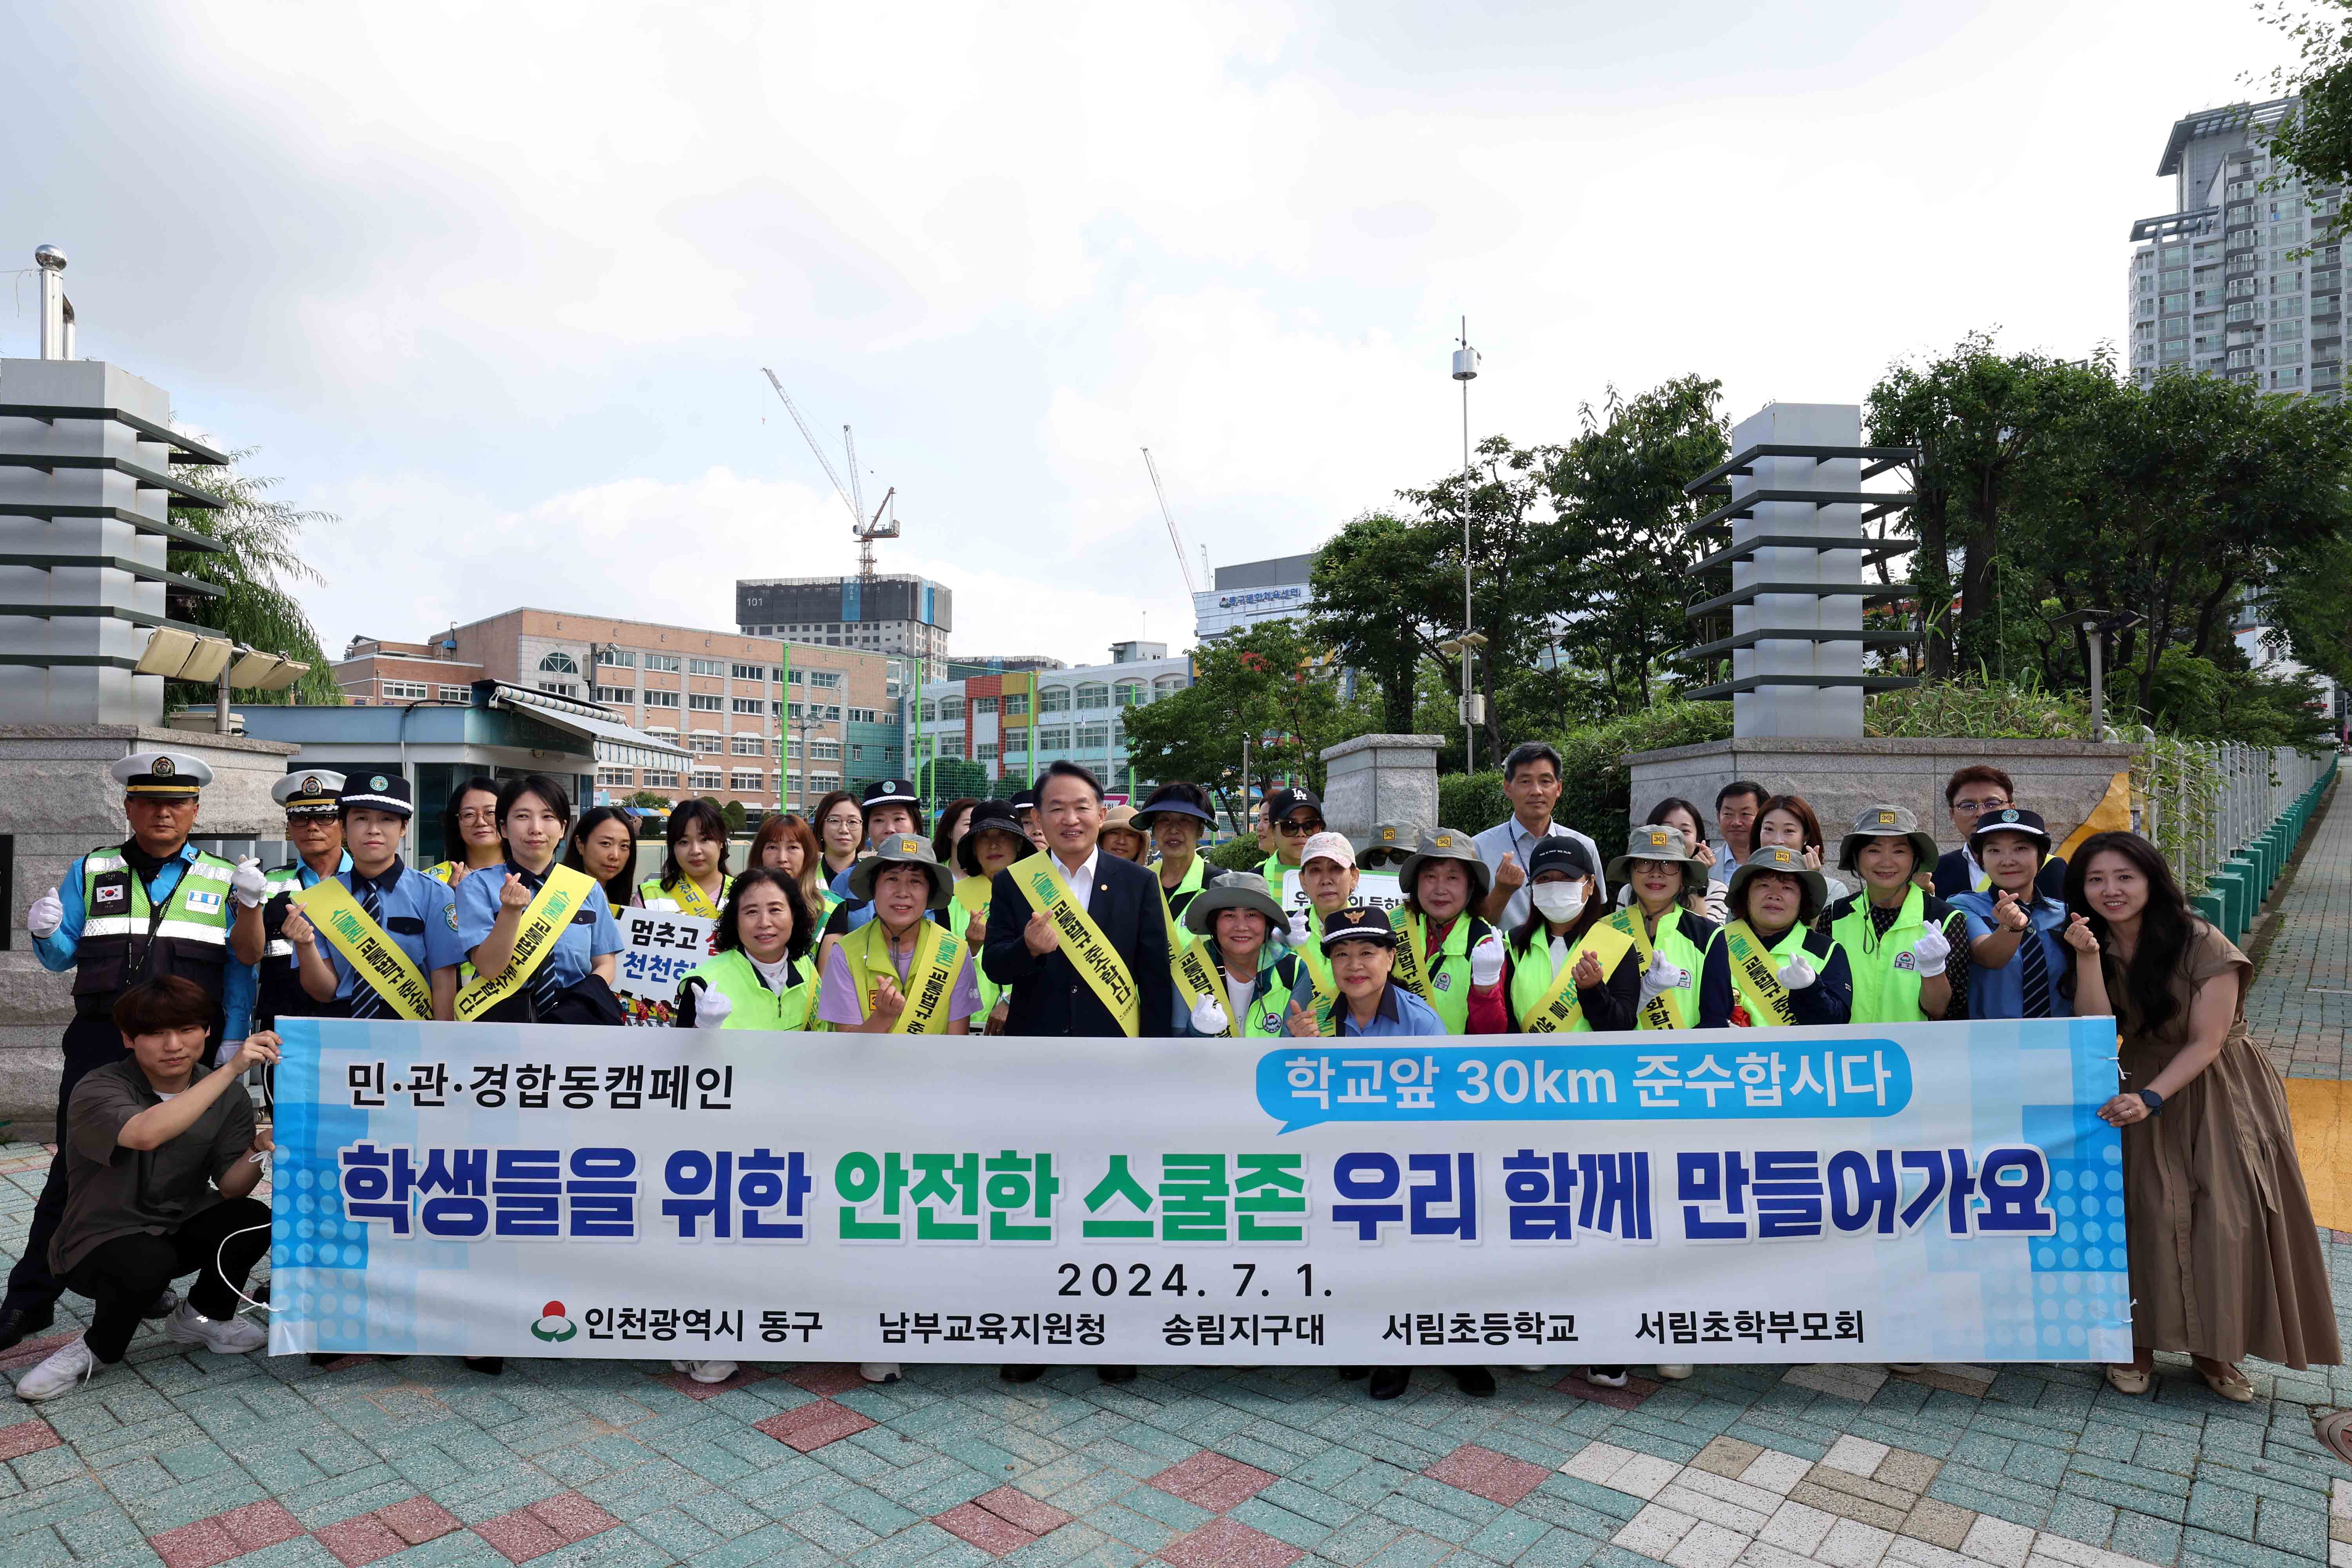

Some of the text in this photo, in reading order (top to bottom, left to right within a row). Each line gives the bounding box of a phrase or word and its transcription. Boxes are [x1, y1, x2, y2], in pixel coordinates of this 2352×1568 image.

[747, 598, 762, 606] 101
[1229, 588, 1299, 606] 동구문화체육센터
[1292, 788, 1307, 800] LA
[330, 909, 367, 944] 스쿨존
[356, 936, 406, 985] 교통법규
[459, 889, 571, 1015] 스쿨존 교통법규 준수합시다
[631, 919, 699, 950] 멈추고
[935, 932, 959, 968] 스쿨존
[1031, 871, 1131, 1005] 스쿨존 교통법규 준수합시다
[1396, 930, 1418, 980] 교통법규
[1727, 933, 1753, 961] 스쿨존
[1742, 955, 1782, 998] 교통법규
[915, 966, 949, 1021] 교통법규
[1284, 1050, 1892, 1109] 학교앞 30km 준수합시다
[342, 1145, 2053, 1241] 학생들을 위한 안전한 스쿨존 우리 함께 만들어가요
[1058, 1263, 1332, 1297] 2024. 7. 1.
[584, 1308, 823, 1343] 인천광역시 동구
[880, 1312, 1105, 1345] 남부교육지원청
[1162, 1314, 1324, 1346] 송림지구대
[1382, 1312, 1579, 1345] 서림초등학교
[1635, 1310, 1864, 1344] 서림초학부모회
